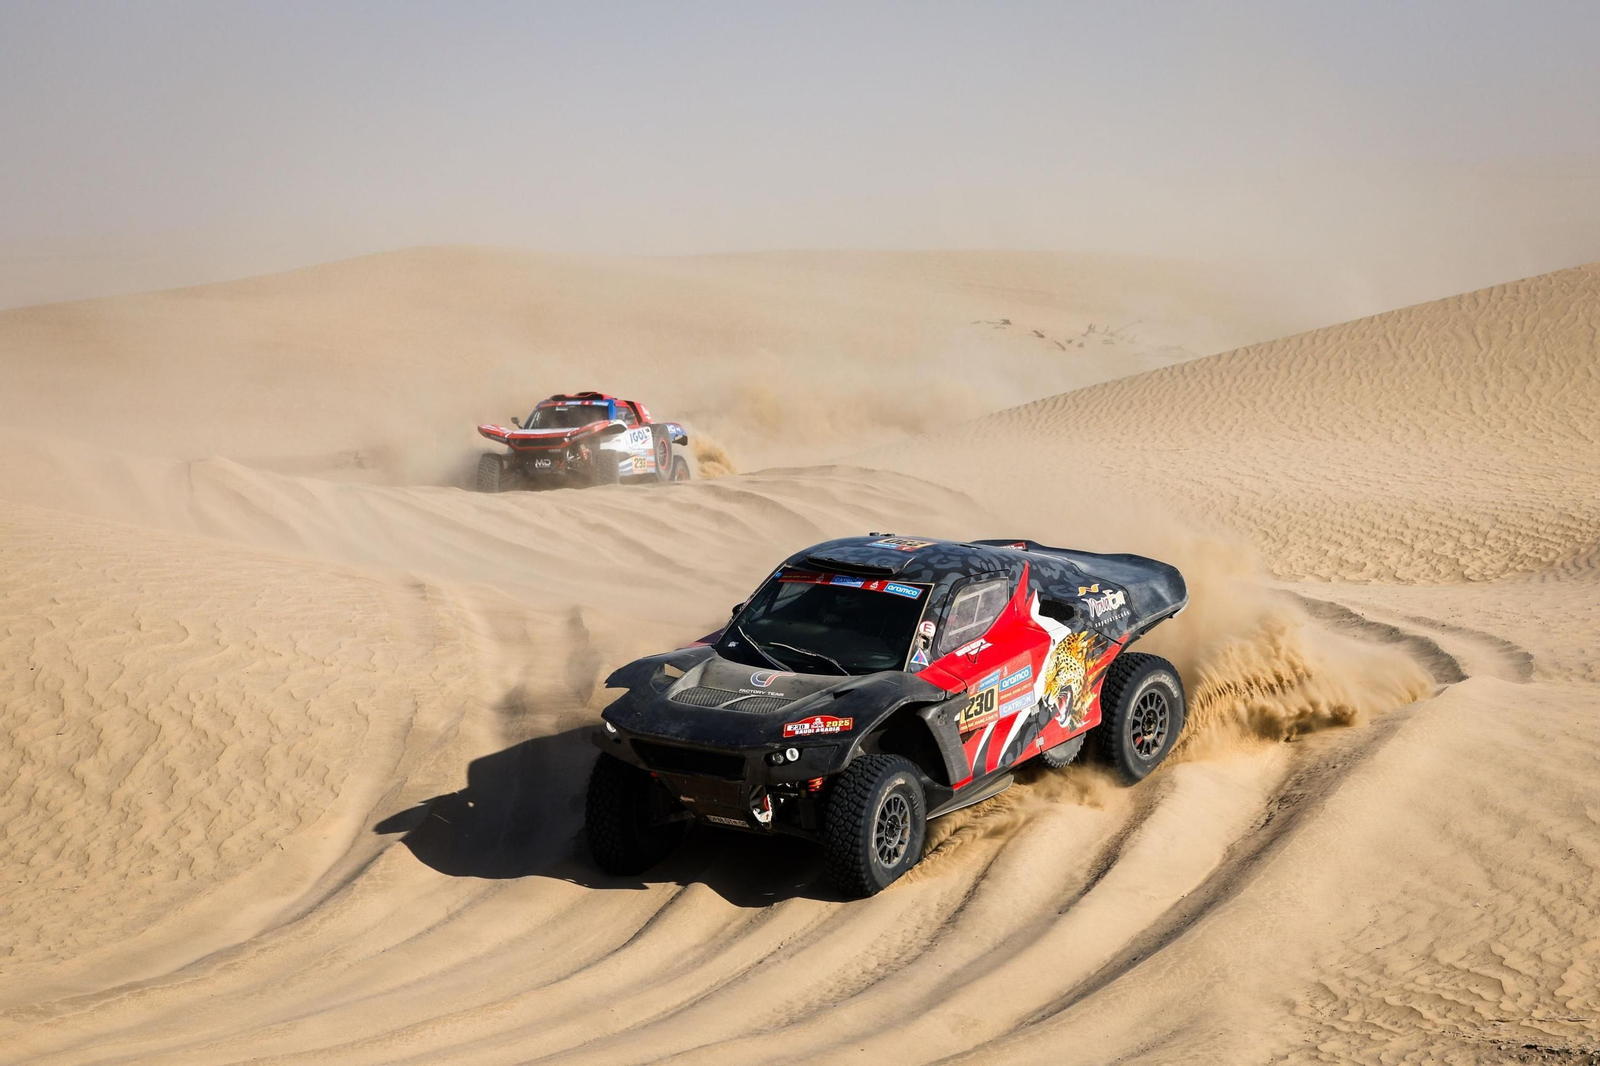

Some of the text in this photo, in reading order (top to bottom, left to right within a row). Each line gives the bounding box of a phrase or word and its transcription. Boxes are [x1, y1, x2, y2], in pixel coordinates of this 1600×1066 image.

[888, 585, 918, 596] aramco
[923, 623, 932, 634] E
[1002, 669, 1030, 688] aramco
[966, 688, 995, 720] 230
[1003, 695, 1032, 713] CATRION
[826, 720, 850, 728] 2025
